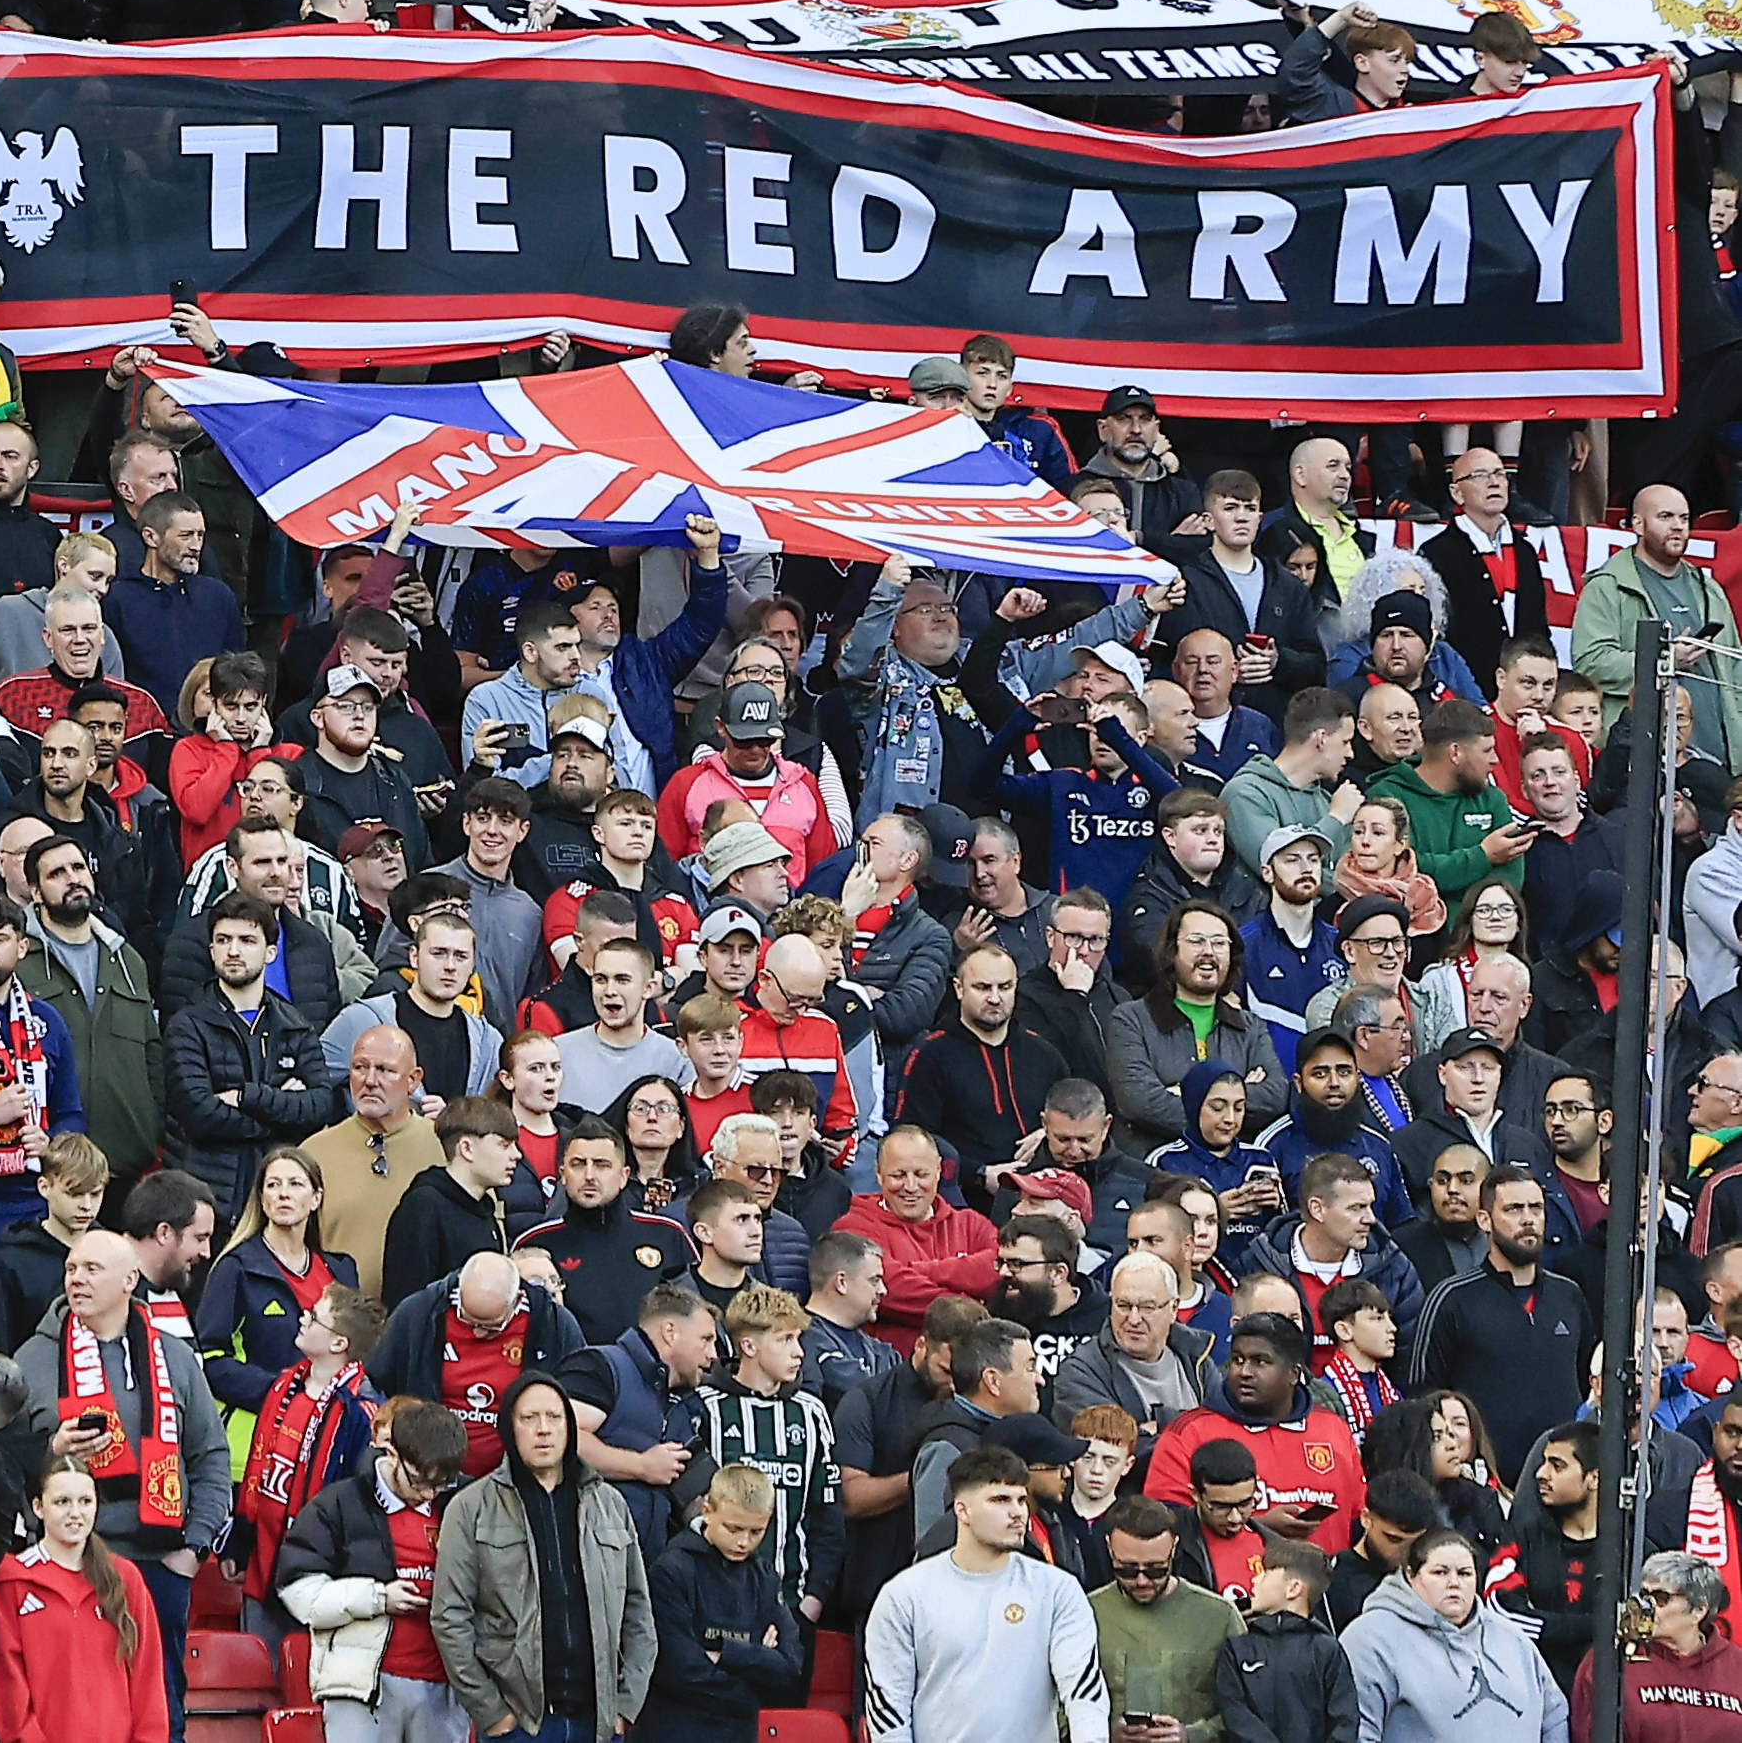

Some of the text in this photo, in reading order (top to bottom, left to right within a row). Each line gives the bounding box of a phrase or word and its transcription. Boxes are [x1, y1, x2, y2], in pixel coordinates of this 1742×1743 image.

[1009, 51, 1114, 81] ALL
[1099, 42, 1284, 81] TEAMS
[15, 203, 44, 217] TRA
[178, 122, 520, 255] THE
[603, 133, 938, 286] RED
[1027, 178, 1594, 305] ARMY
[741, 700, 772, 721] AW
[1091, 814, 1156, 838] Tezos
